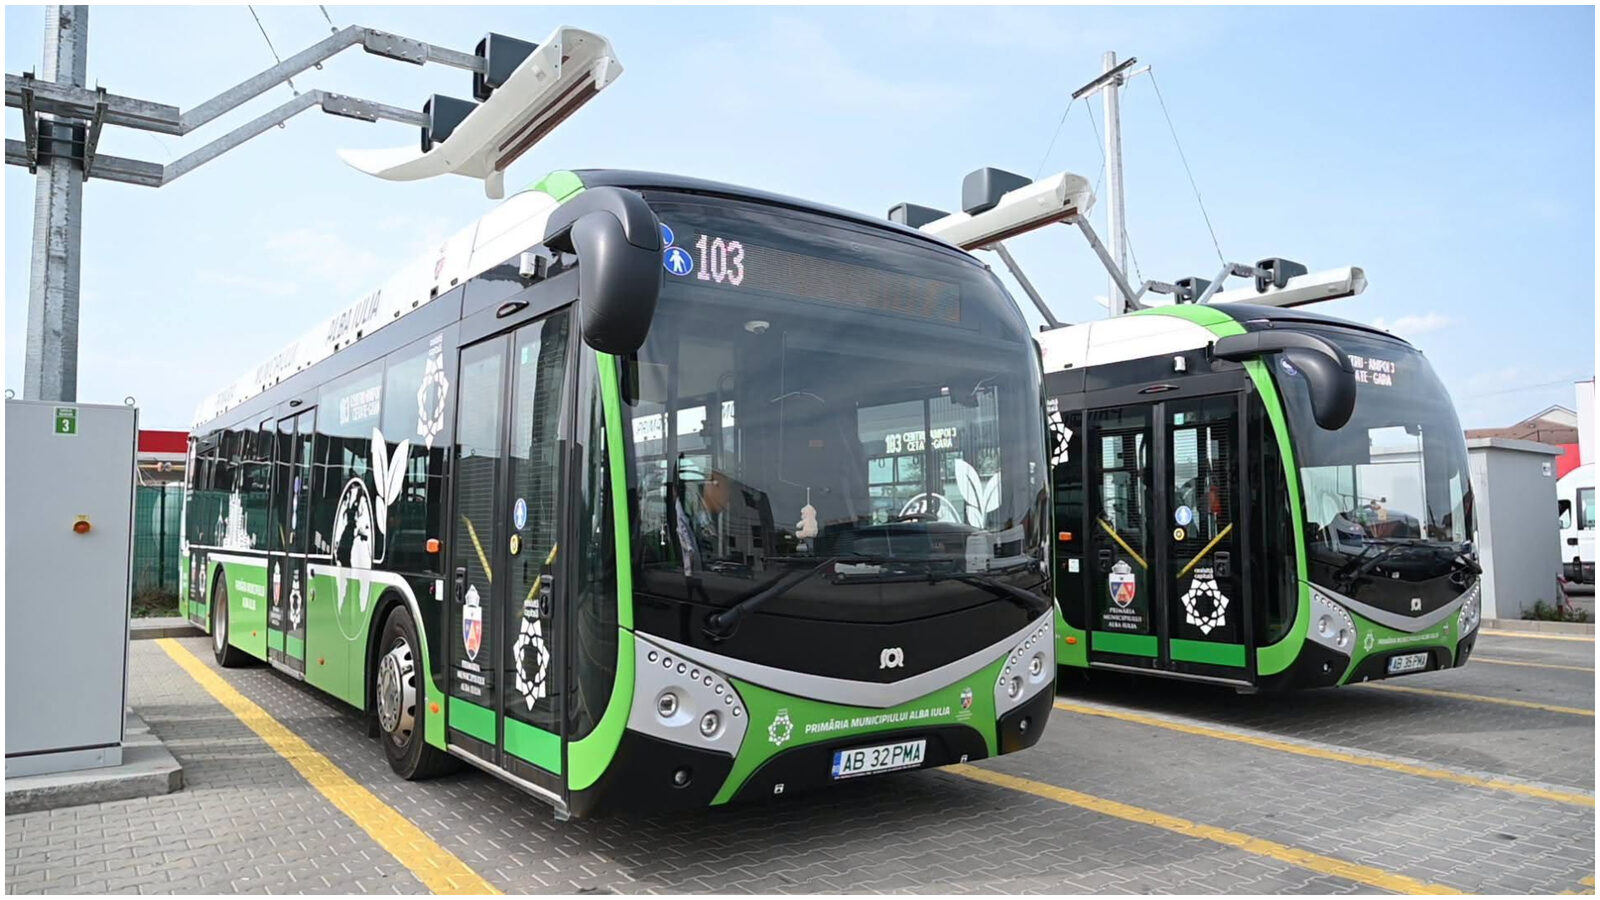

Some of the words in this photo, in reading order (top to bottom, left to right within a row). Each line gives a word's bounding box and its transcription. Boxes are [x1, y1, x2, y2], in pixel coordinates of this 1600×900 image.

[695, 234, 745, 286] 103
[62, 419, 70, 432] 3
[805, 718, 849, 734] PRIMĂRIA
[850, 712, 908, 728] MUNICIPIULUI
[908, 710, 930, 721] ALBA
[930, 706, 951, 717] IULIA
[842, 751, 865, 773] AB
